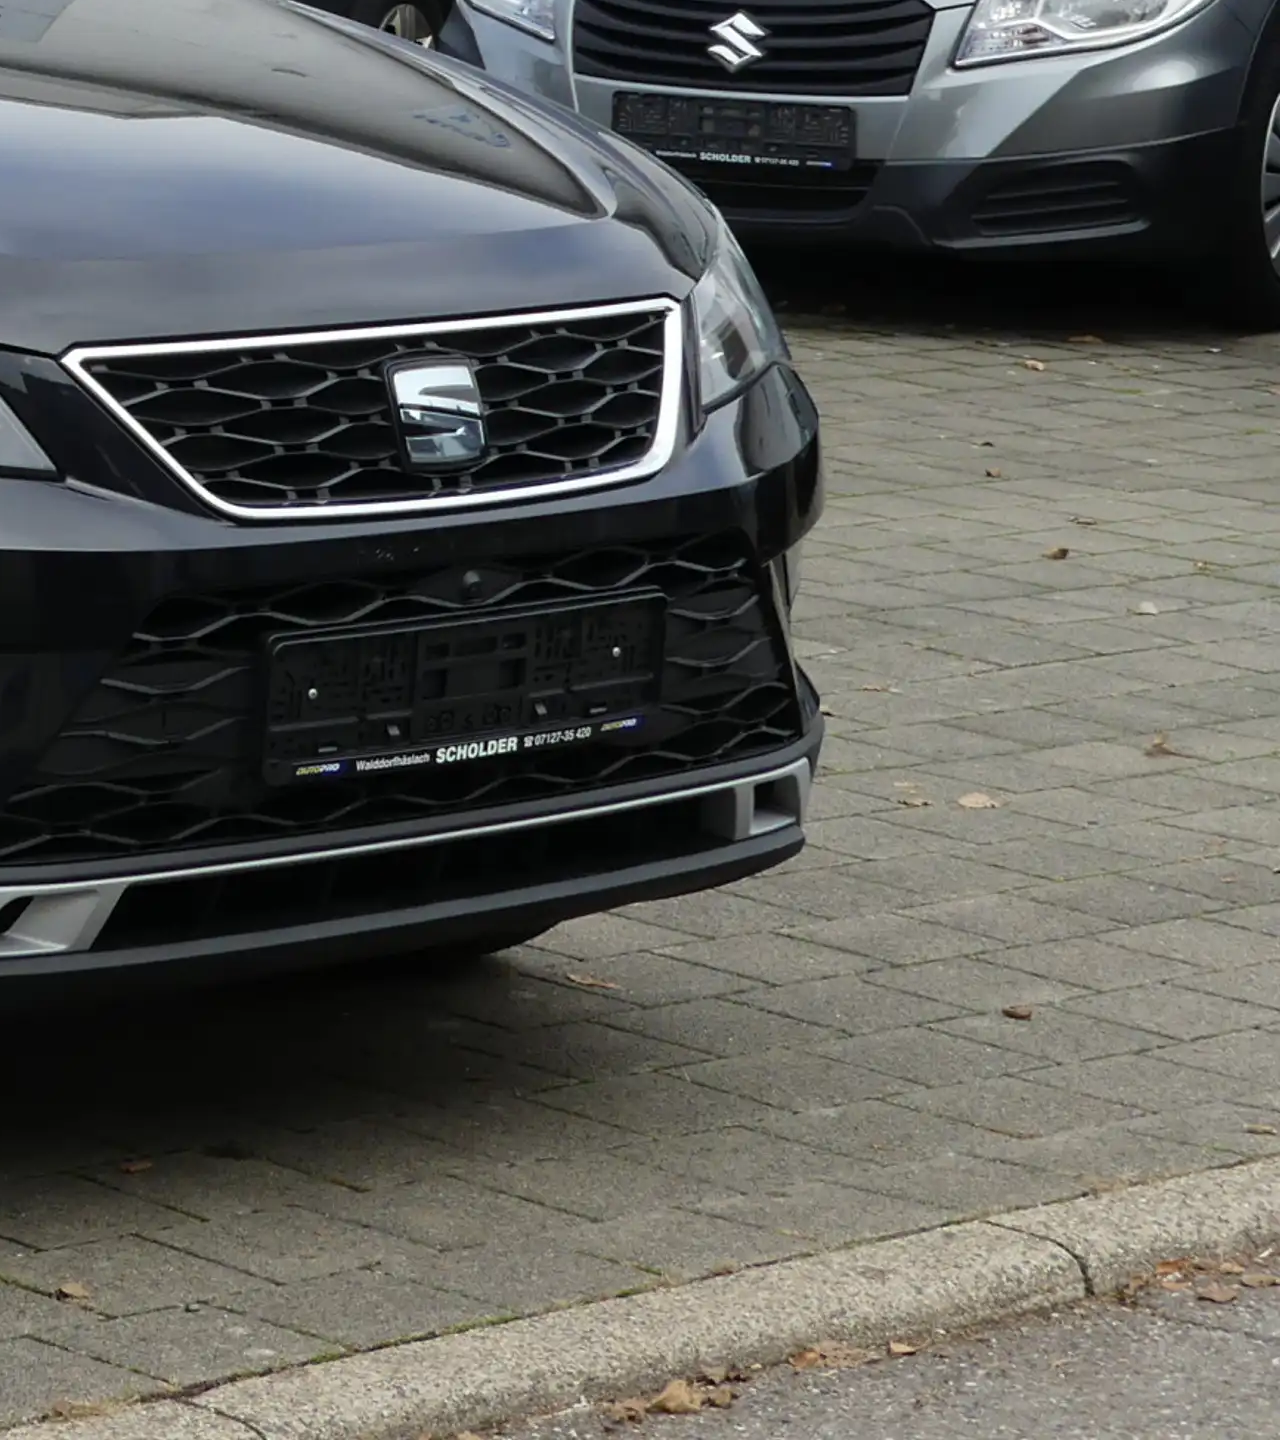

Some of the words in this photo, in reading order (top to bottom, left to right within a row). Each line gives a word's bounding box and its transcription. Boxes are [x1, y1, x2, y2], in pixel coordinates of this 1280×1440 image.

[699, 151, 752, 164] SCHOLDER
[435, 735, 519, 764] SCHOLDER
[575, 726, 592, 740] 420
